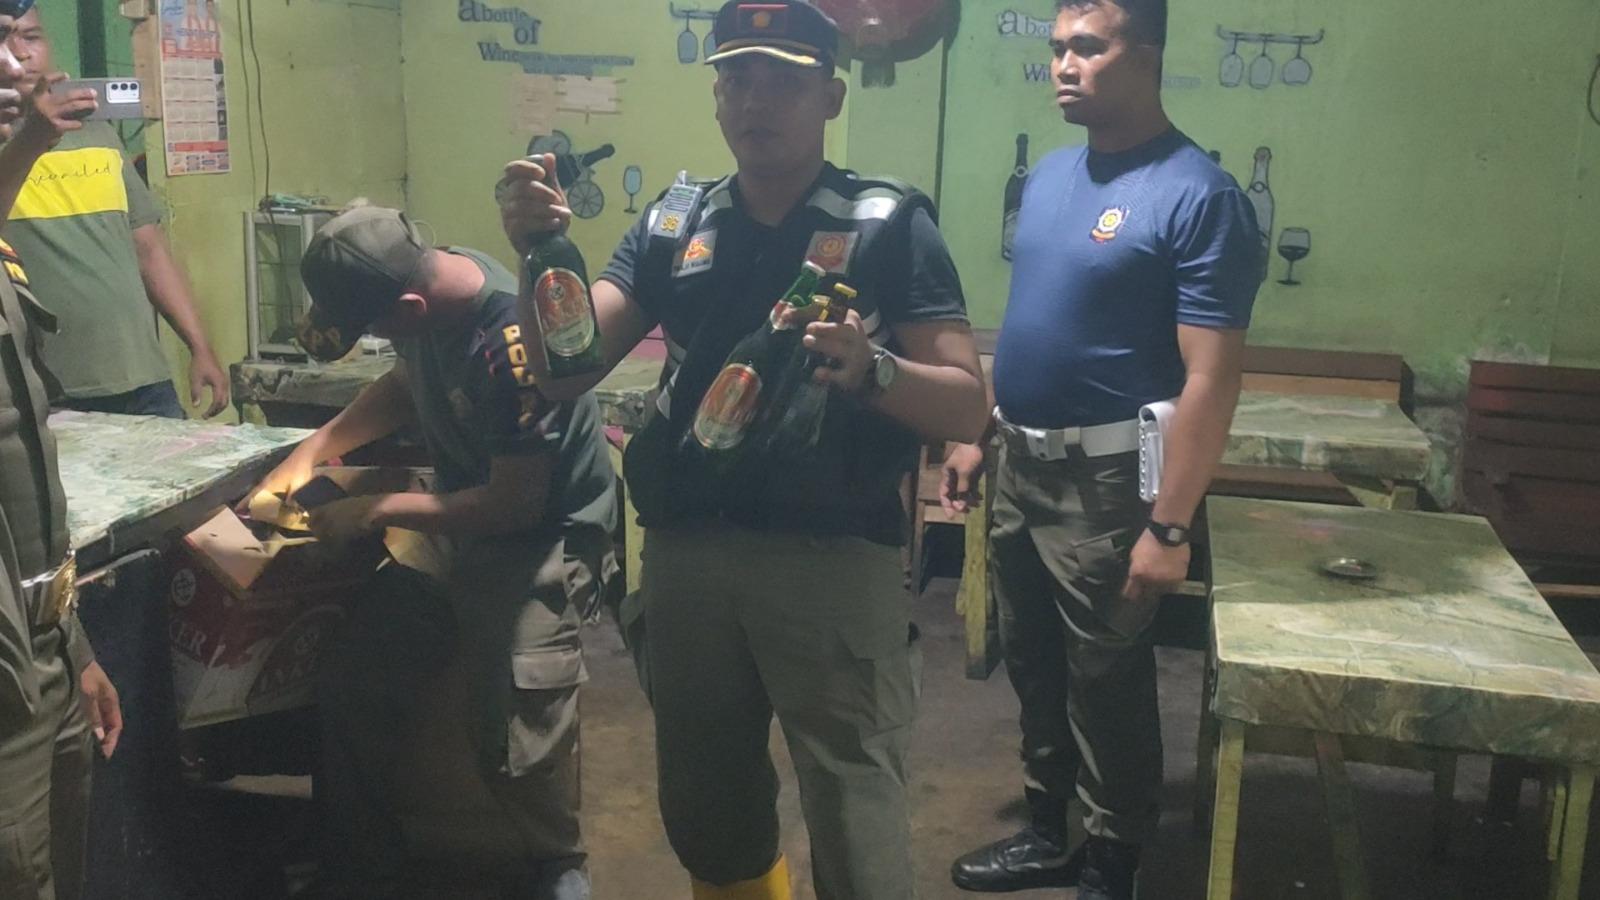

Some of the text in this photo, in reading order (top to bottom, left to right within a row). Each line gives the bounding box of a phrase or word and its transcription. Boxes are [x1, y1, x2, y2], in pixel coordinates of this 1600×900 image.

[458, 0, 529, 22] a bottle
[998, 9, 1020, 35] a
[514, 20, 541, 44] of
